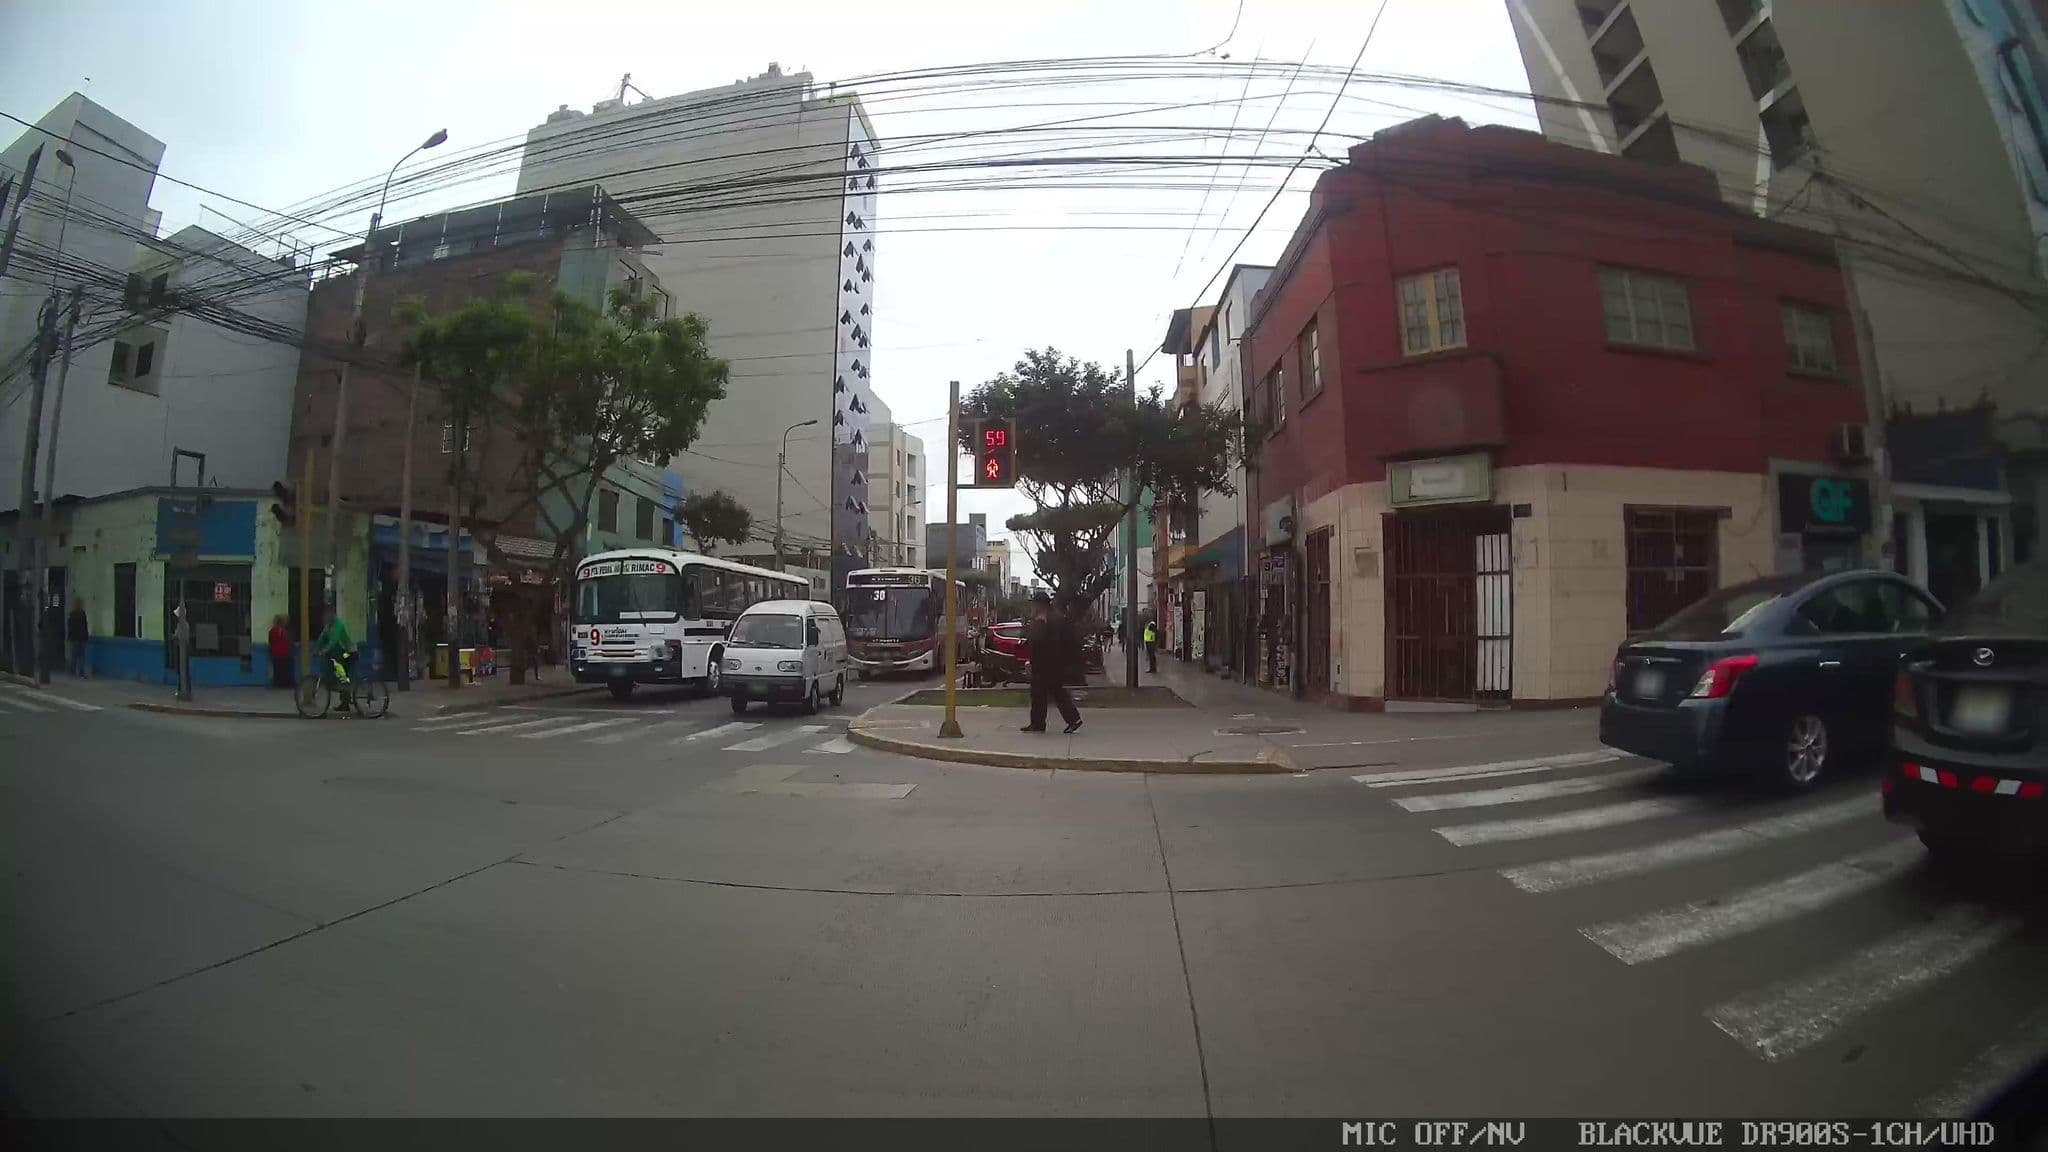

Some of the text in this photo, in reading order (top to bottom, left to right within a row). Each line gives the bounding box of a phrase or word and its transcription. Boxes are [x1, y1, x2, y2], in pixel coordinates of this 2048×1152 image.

[985, 430, 1005, 446] 59
[631, 563, 655, 573] RIMAC
[656, 562, 667, 573] 9
[590, 628, 600, 646] 9
